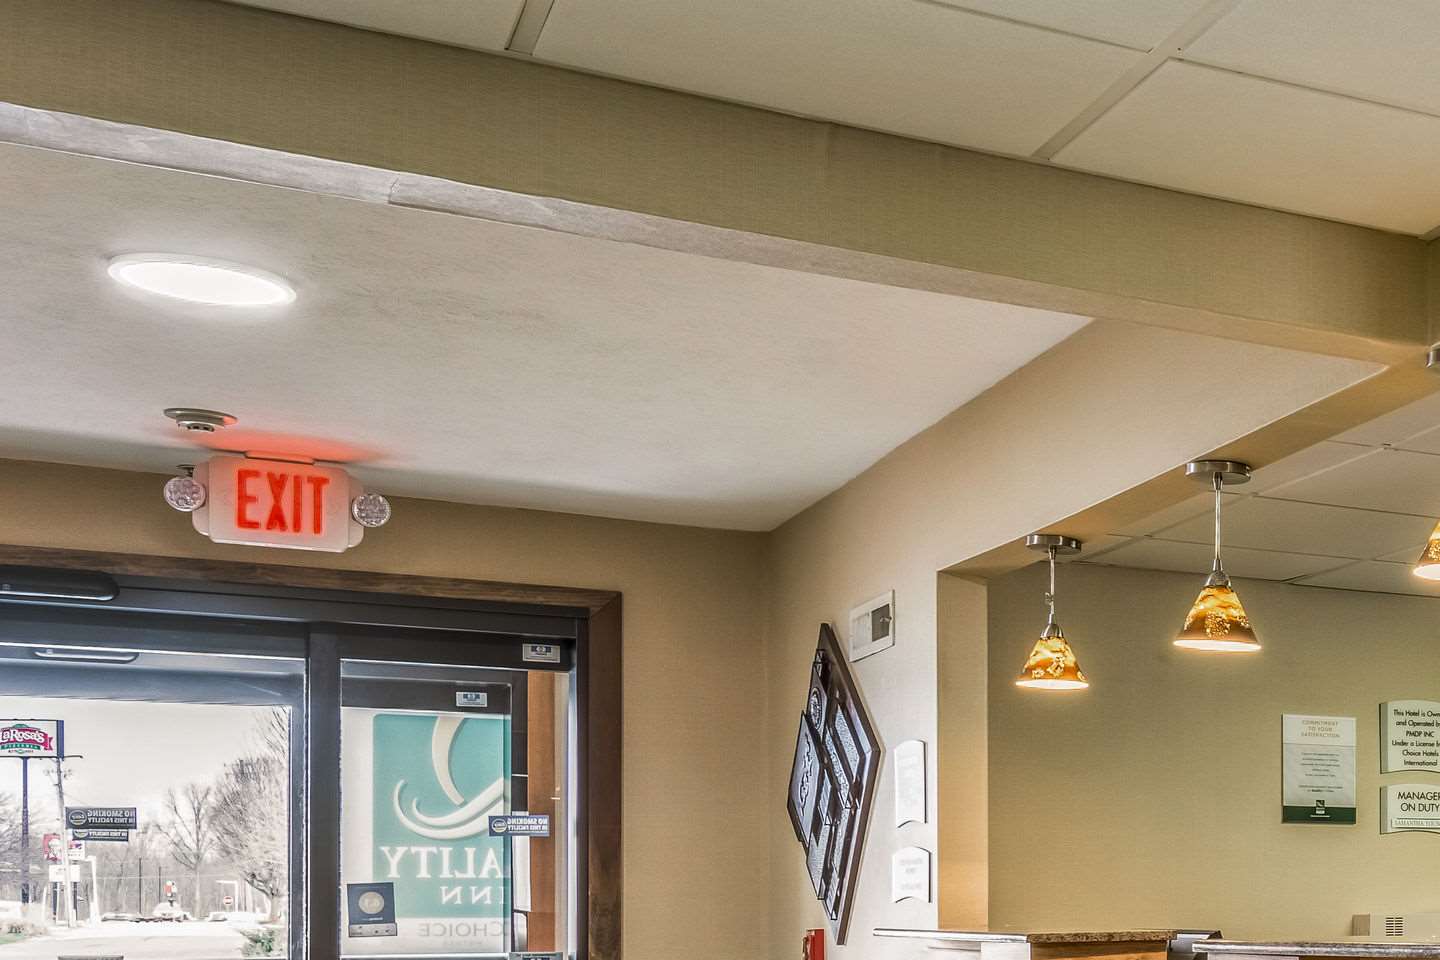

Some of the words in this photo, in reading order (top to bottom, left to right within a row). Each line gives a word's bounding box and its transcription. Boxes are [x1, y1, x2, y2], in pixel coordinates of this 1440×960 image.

[237, 469, 330, 535] EXIT
[1405, 709, 1420, 717] Hotel
[1400, 802, 1416, 812] ON
[1418, 803, 1440, 812] DUTY
